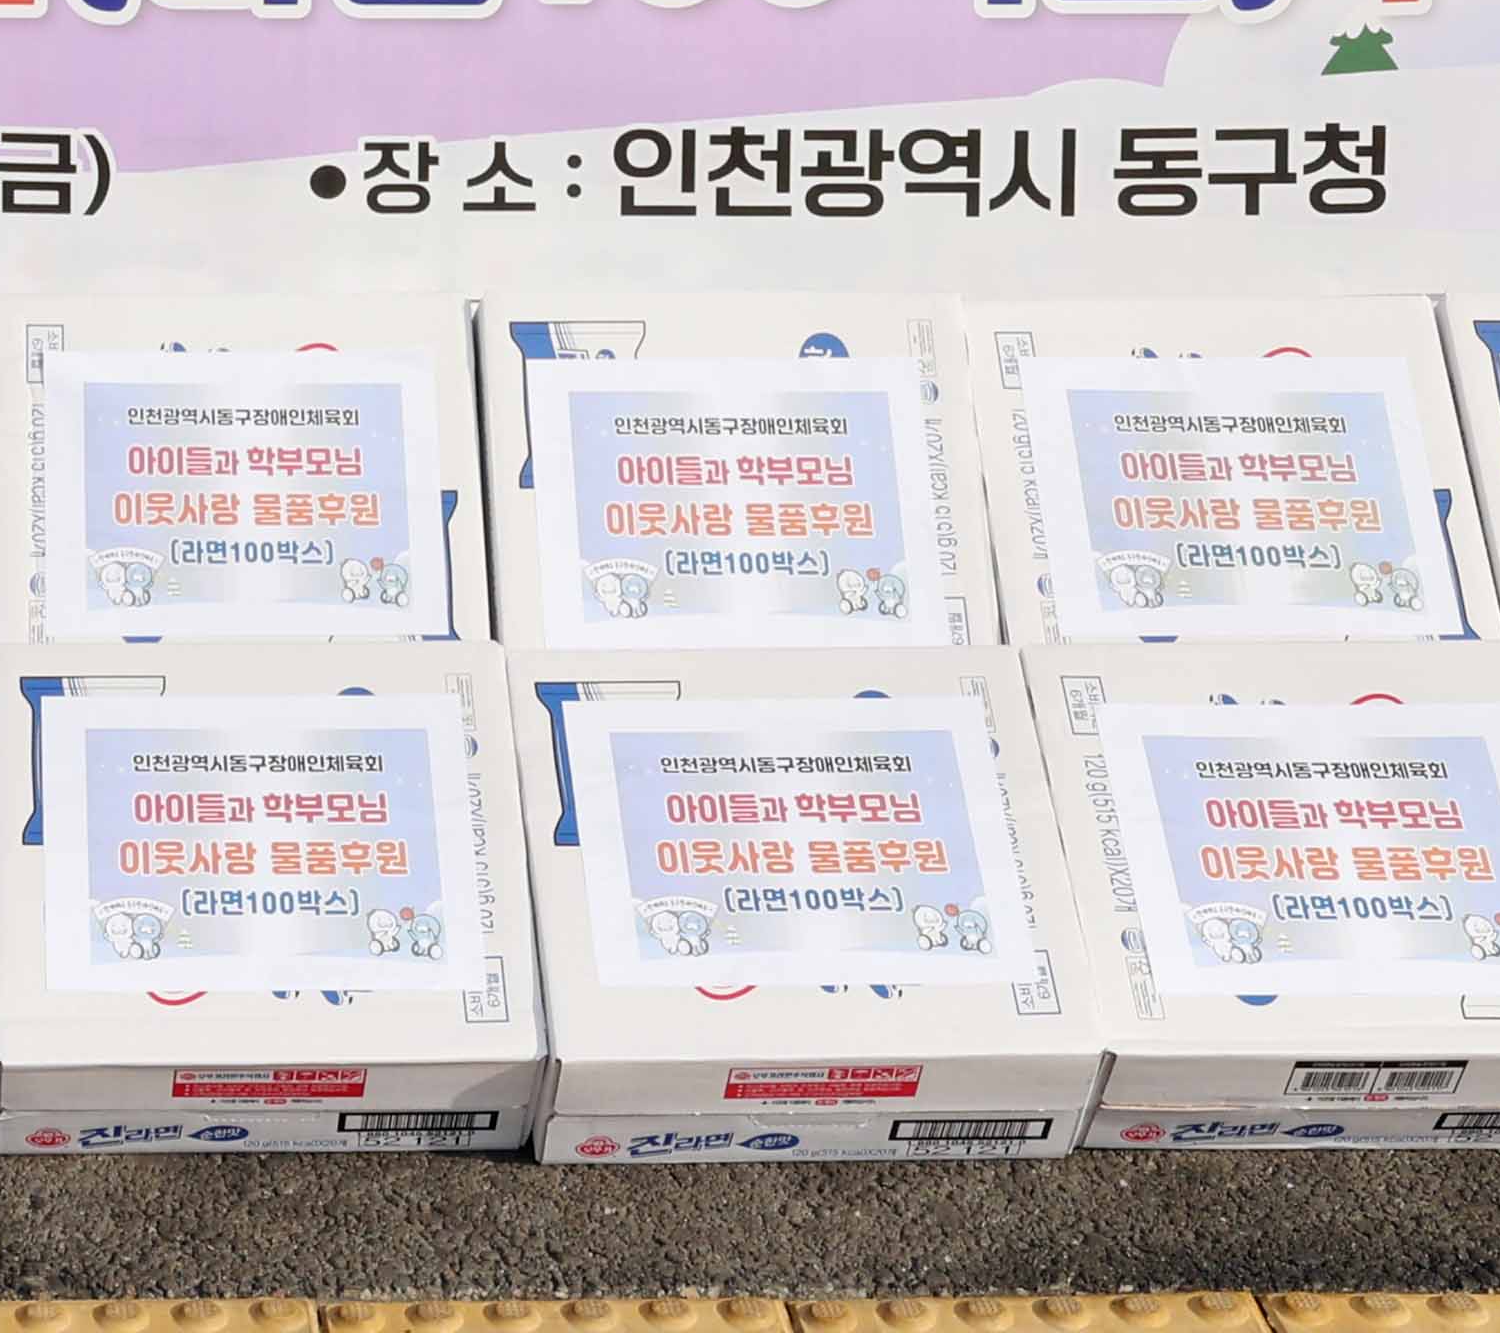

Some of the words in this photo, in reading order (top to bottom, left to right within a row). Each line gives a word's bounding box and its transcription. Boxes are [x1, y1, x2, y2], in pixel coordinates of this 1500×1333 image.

[610, 123, 1081, 220] 인천광역시
[1111, 119, 1390, 216] 동구청
[133, 755, 383, 772] 인천광역시동구장애인체육회
[135, 794, 255, 823] 아이들과
[262, 793, 387, 823] 학부모님
[120, 841, 256, 874] 이웃사랑
[271, 841, 408, 874] 물품후원
